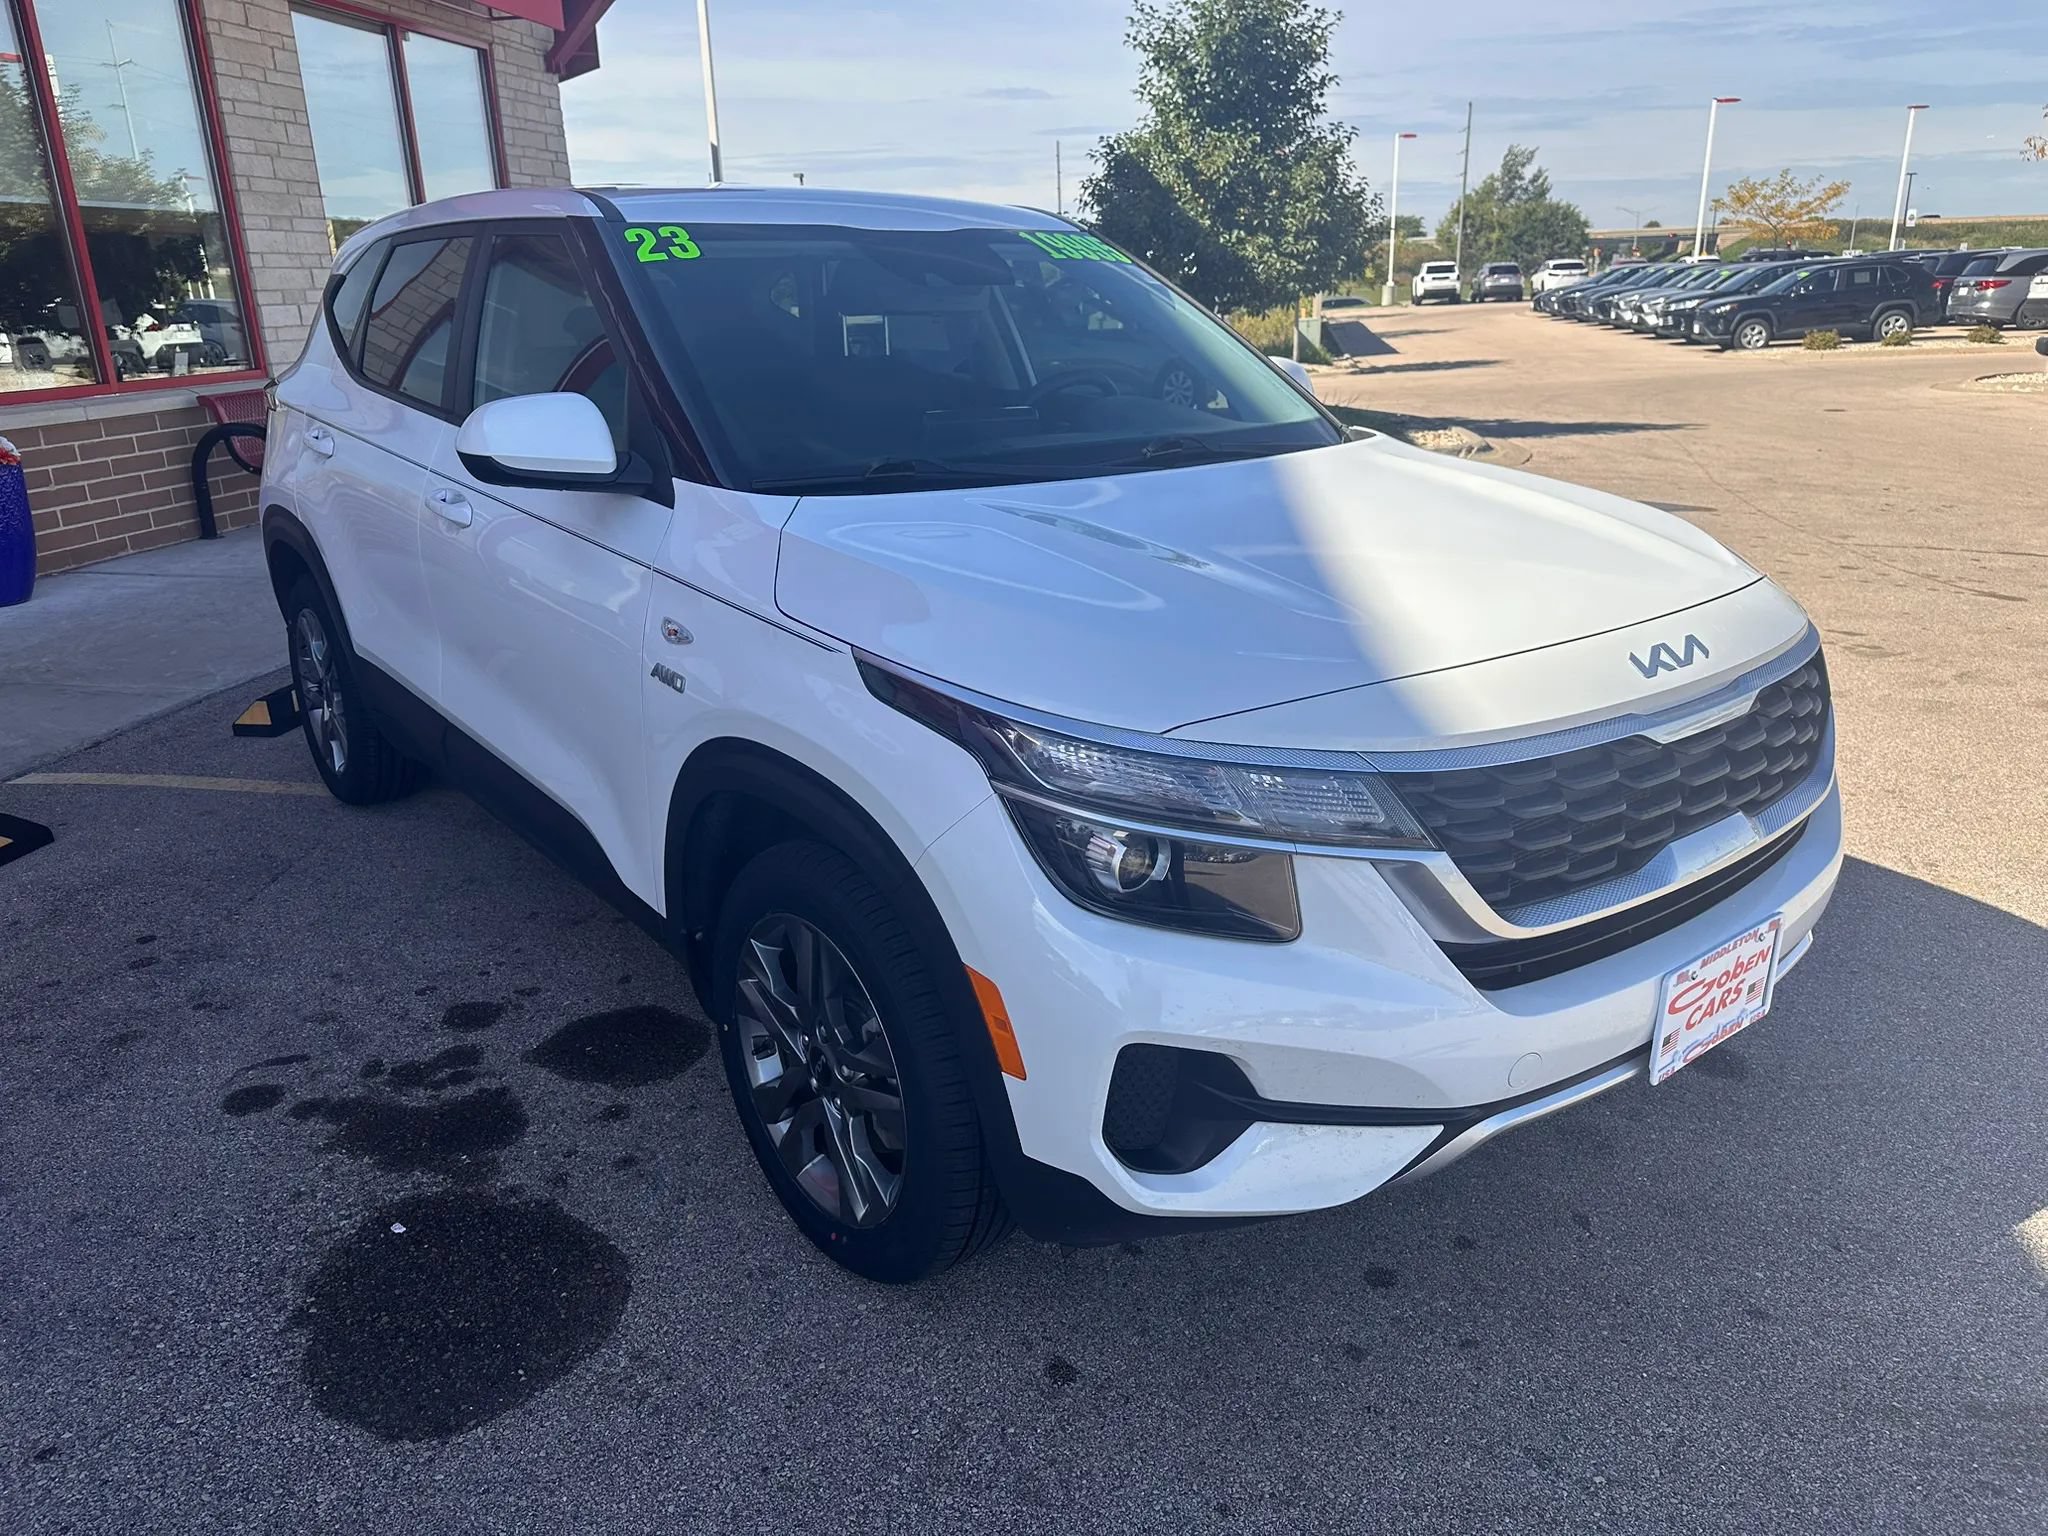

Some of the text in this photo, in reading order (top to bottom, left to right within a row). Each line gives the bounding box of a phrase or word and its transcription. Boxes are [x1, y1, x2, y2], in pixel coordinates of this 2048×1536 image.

[623, 225, 702, 263] 23
[1018, 230, 1133, 264] 19995
[650, 662, 687, 694] AWD
[1700, 928, 1760, 969] MIDDLETON
[1685, 979, 1745, 1031] CARS
